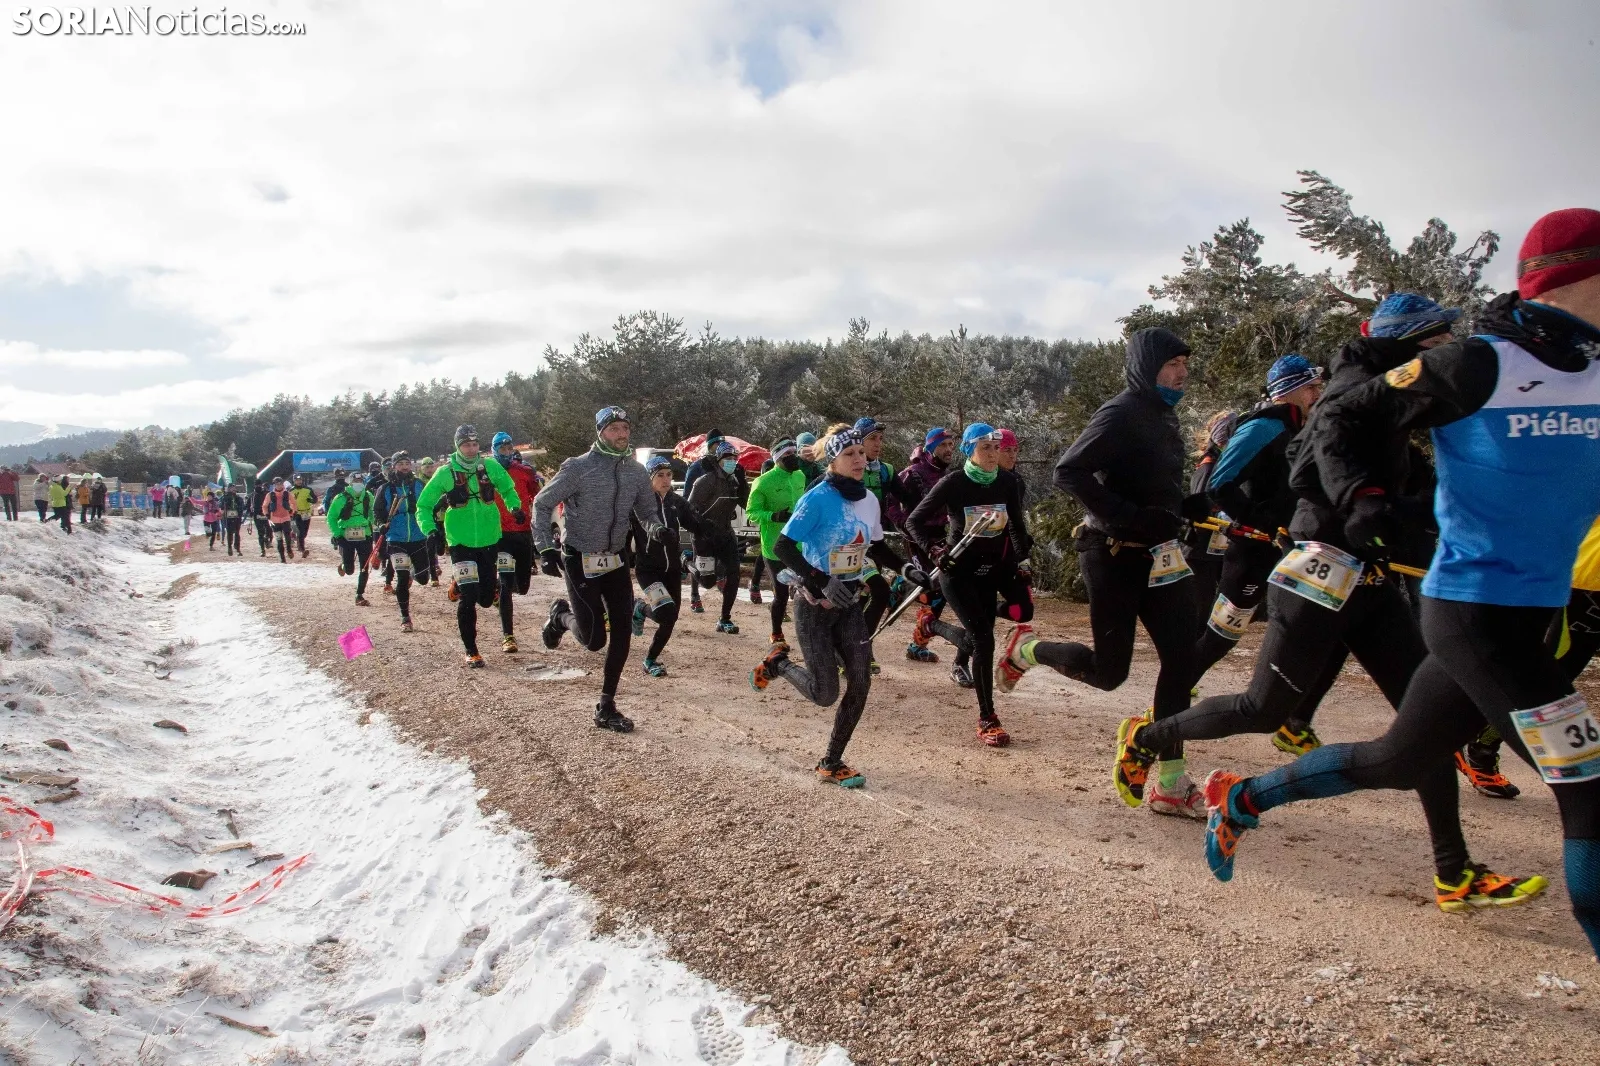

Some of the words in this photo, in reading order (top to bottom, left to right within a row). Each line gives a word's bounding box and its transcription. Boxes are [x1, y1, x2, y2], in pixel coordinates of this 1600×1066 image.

[1506, 410, 1600, 440] Piélag
[597, 557, 608, 568] 41
[846, 554, 858, 566] 15
[1162, 553, 1171, 567] 50
[460, 567, 469, 575] 49
[1305, 558, 1331, 580] 38
[1226, 614, 1242, 628] 74
[1565, 718, 1599, 748] 36
